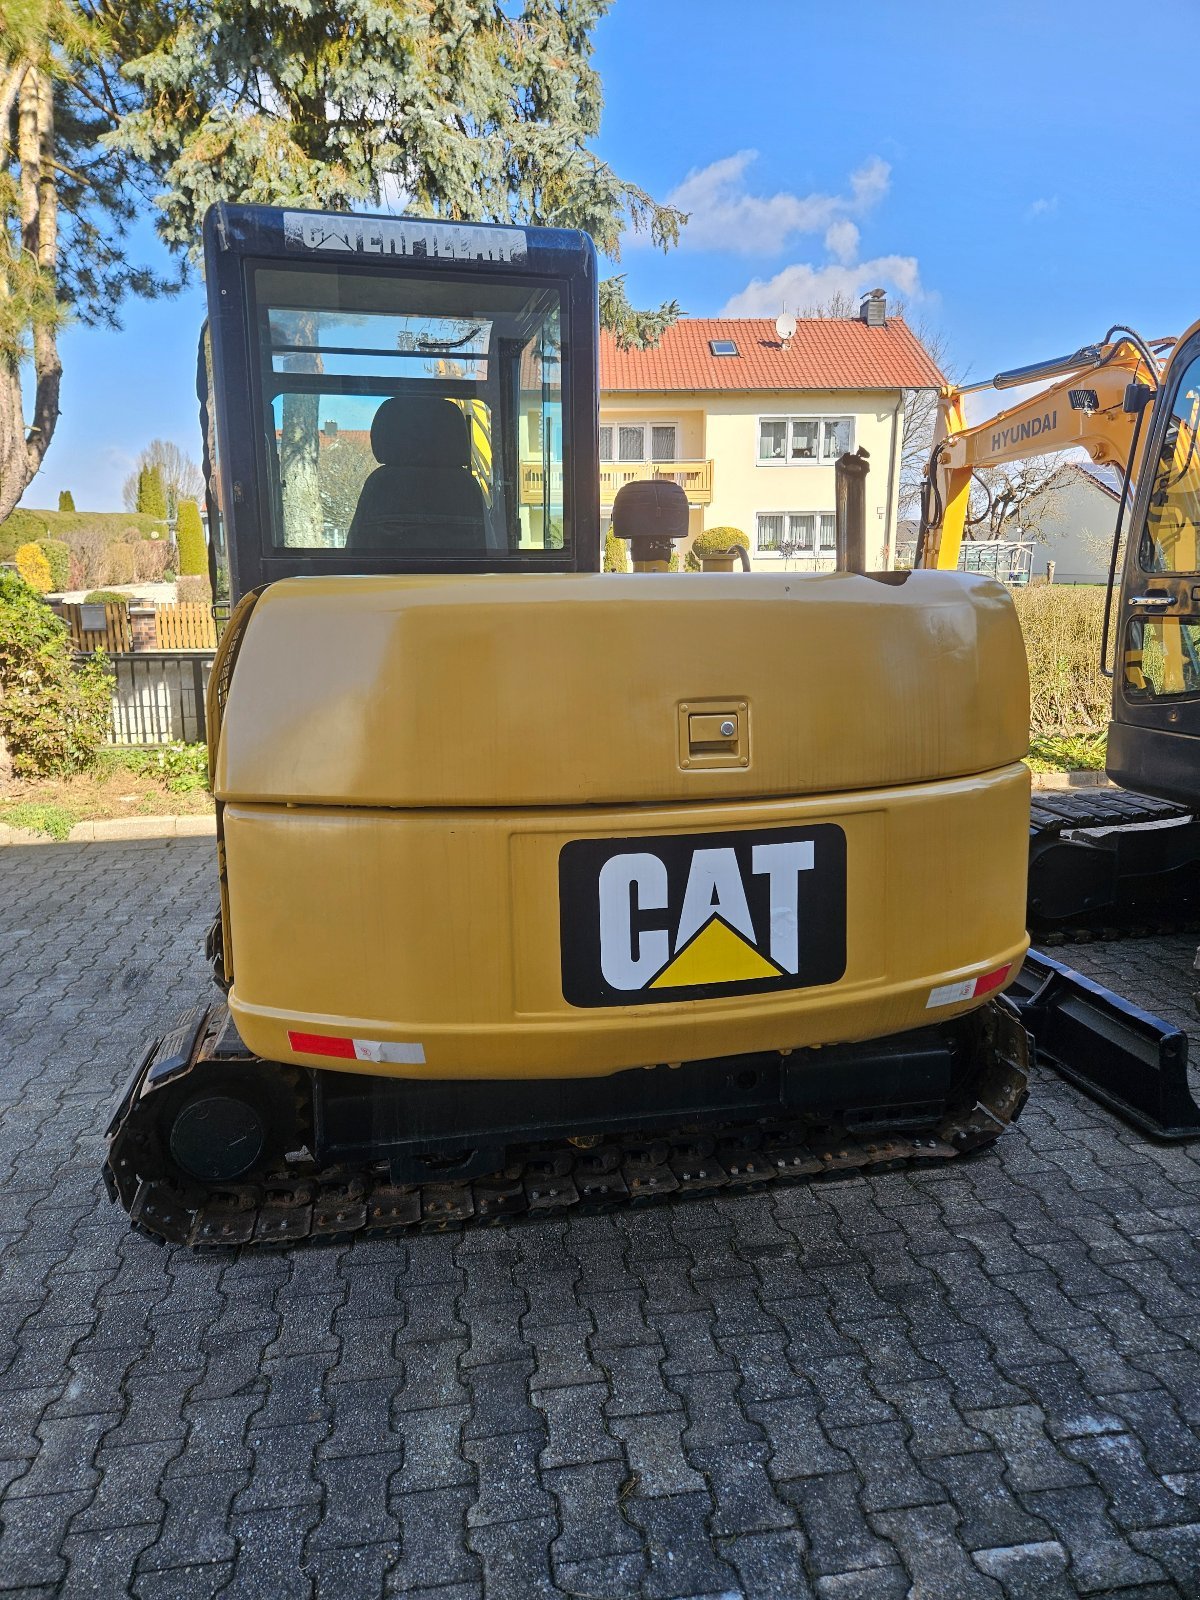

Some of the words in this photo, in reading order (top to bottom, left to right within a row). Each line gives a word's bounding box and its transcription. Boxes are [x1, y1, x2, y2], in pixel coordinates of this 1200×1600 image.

[302, 215, 512, 262] CATERPILLAR
[991, 410, 1057, 452] HYUNDAI
[598, 840, 815, 991] CAT
